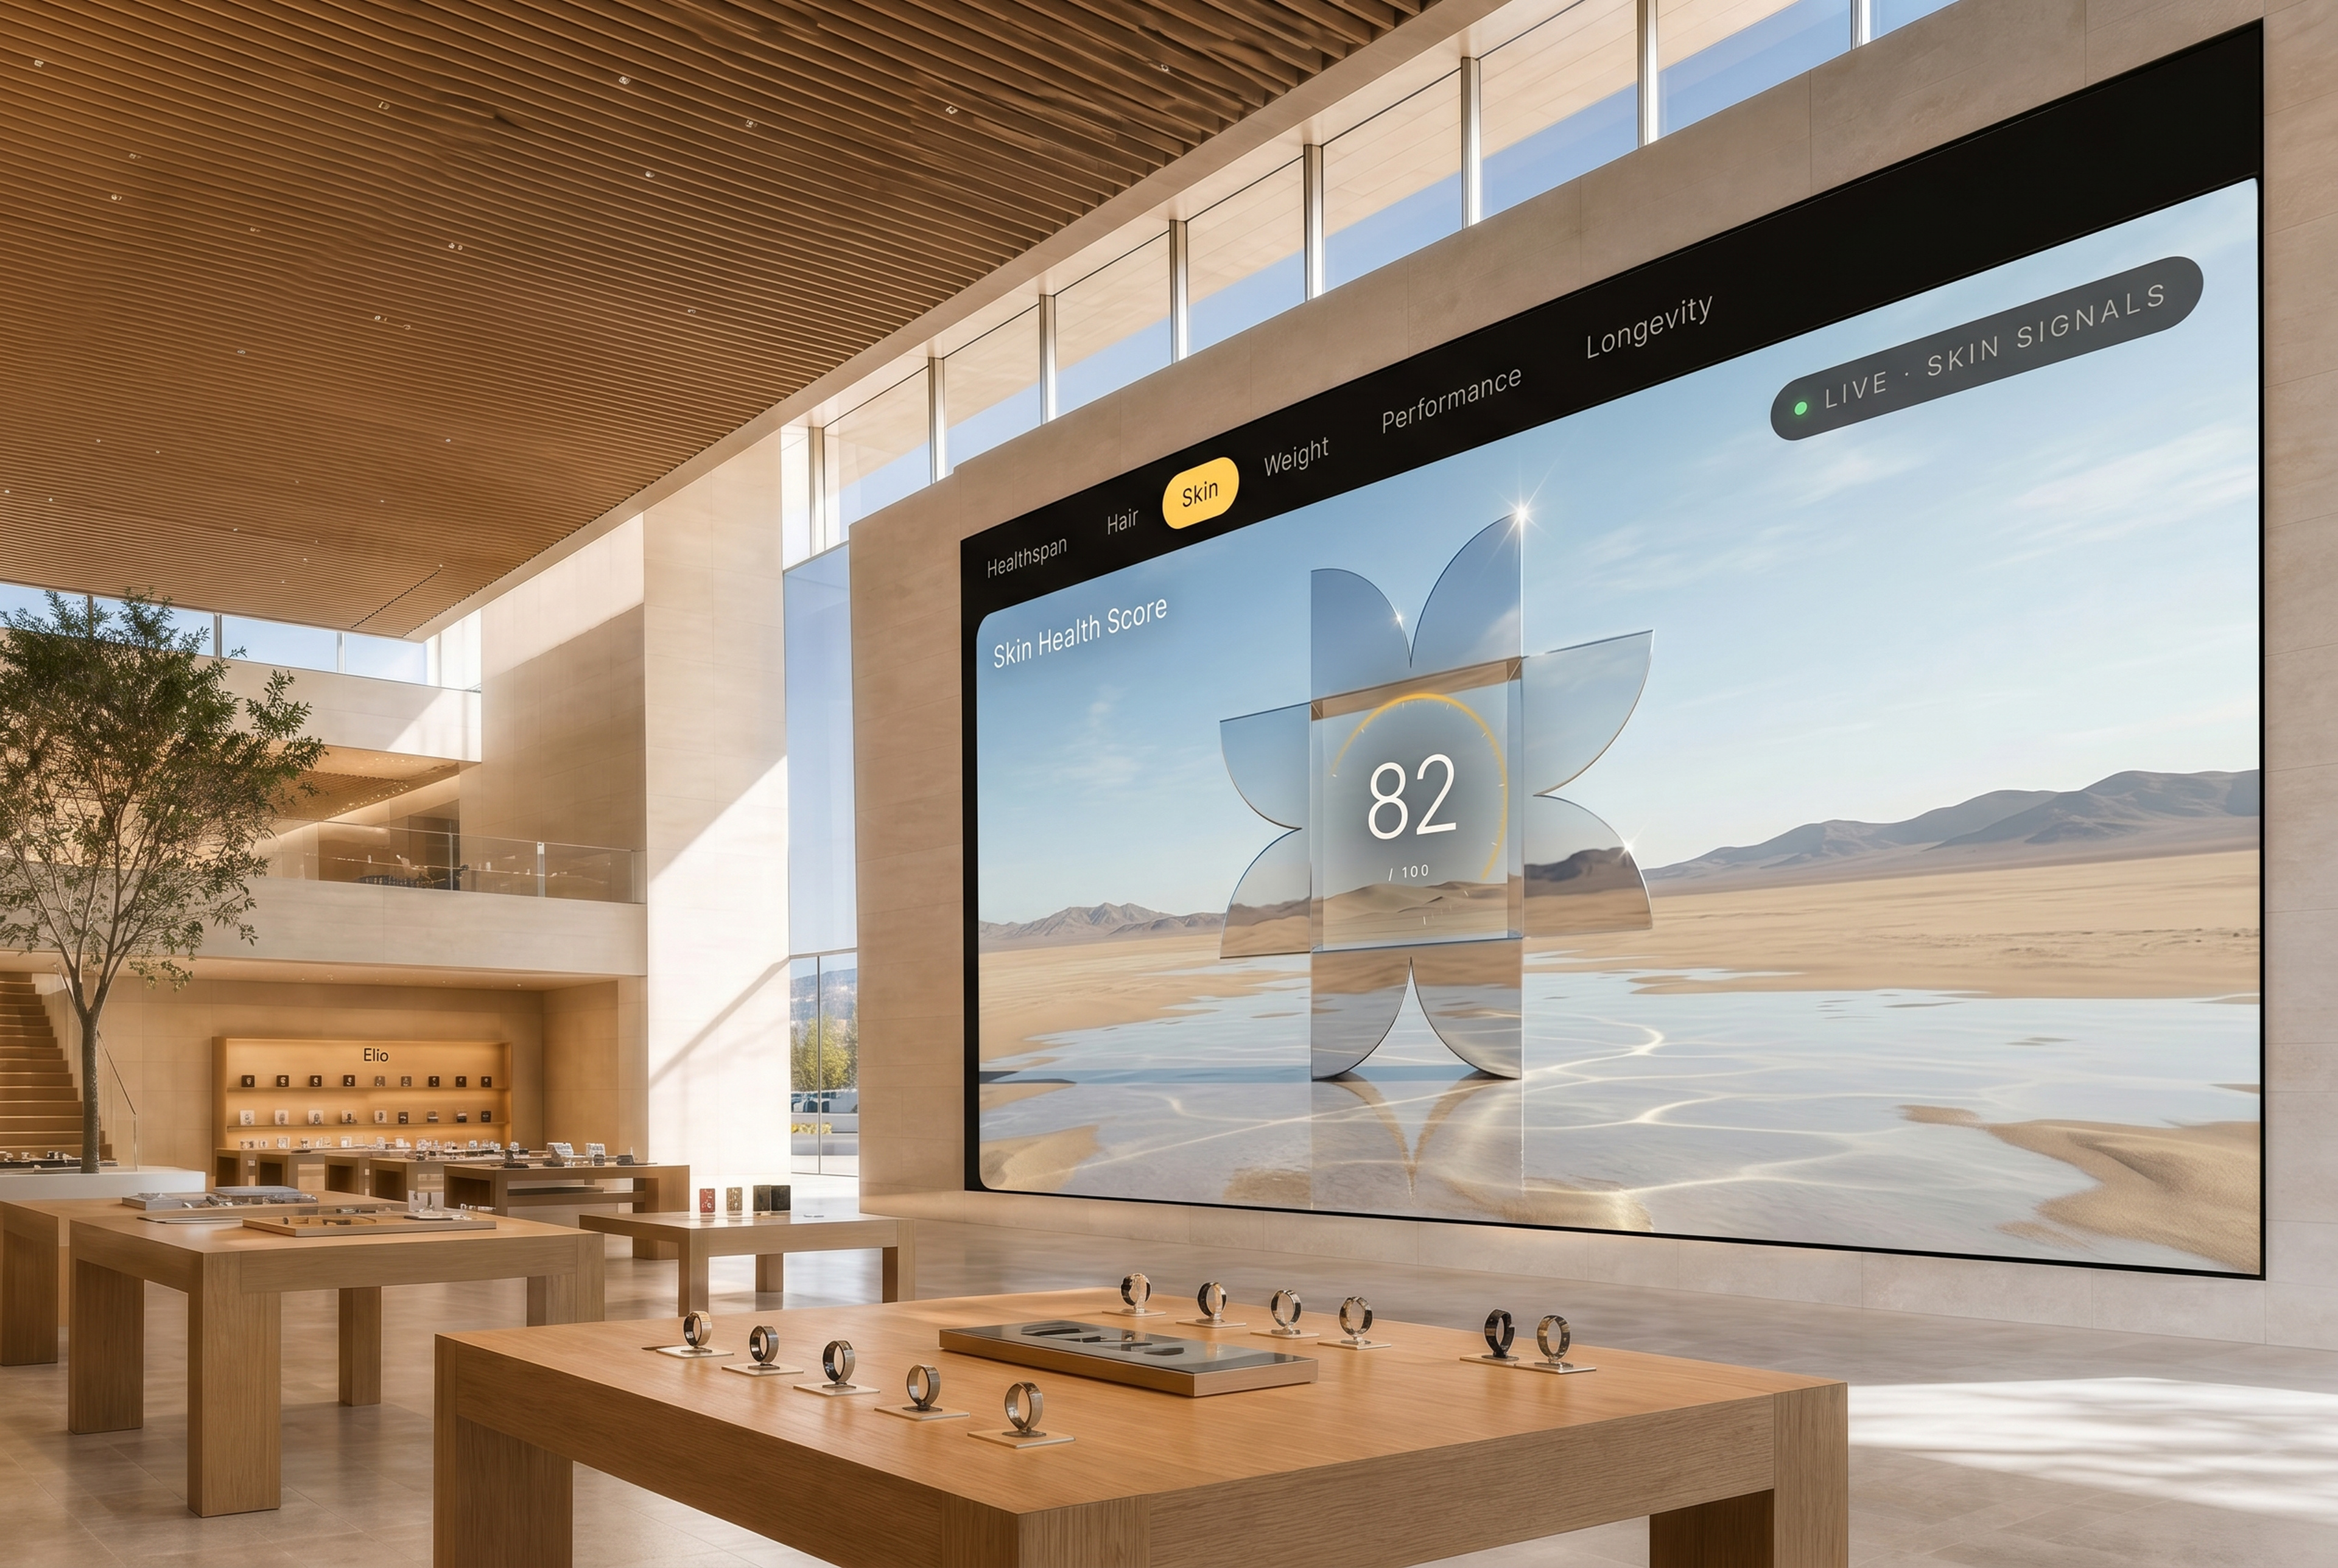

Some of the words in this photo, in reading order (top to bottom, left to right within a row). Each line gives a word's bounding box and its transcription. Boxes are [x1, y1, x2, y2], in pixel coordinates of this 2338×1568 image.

[1825, 371, 1887, 408] LIVE
[1927, 335, 1998, 377] SKIN
[2017, 284, 2165, 348] SIGNALS
[986, 536, 1067, 578] Healthspan
[1107, 508, 1139, 535] Hair
[1182, 481, 1218, 508] Skin
[1264, 436, 1329, 477] Weight
[1382, 368, 1522, 433] Performance
[1587, 296, 1713, 359] Longevity
[993, 639, 1032, 669] Skin
[1039, 615, 1100, 656] Health
[1108, 598, 1168, 634] Score
[1367, 754, 1456, 840] 82
[1402, 864, 1429, 878] 100
[363, 1048, 389, 1063] Elio
